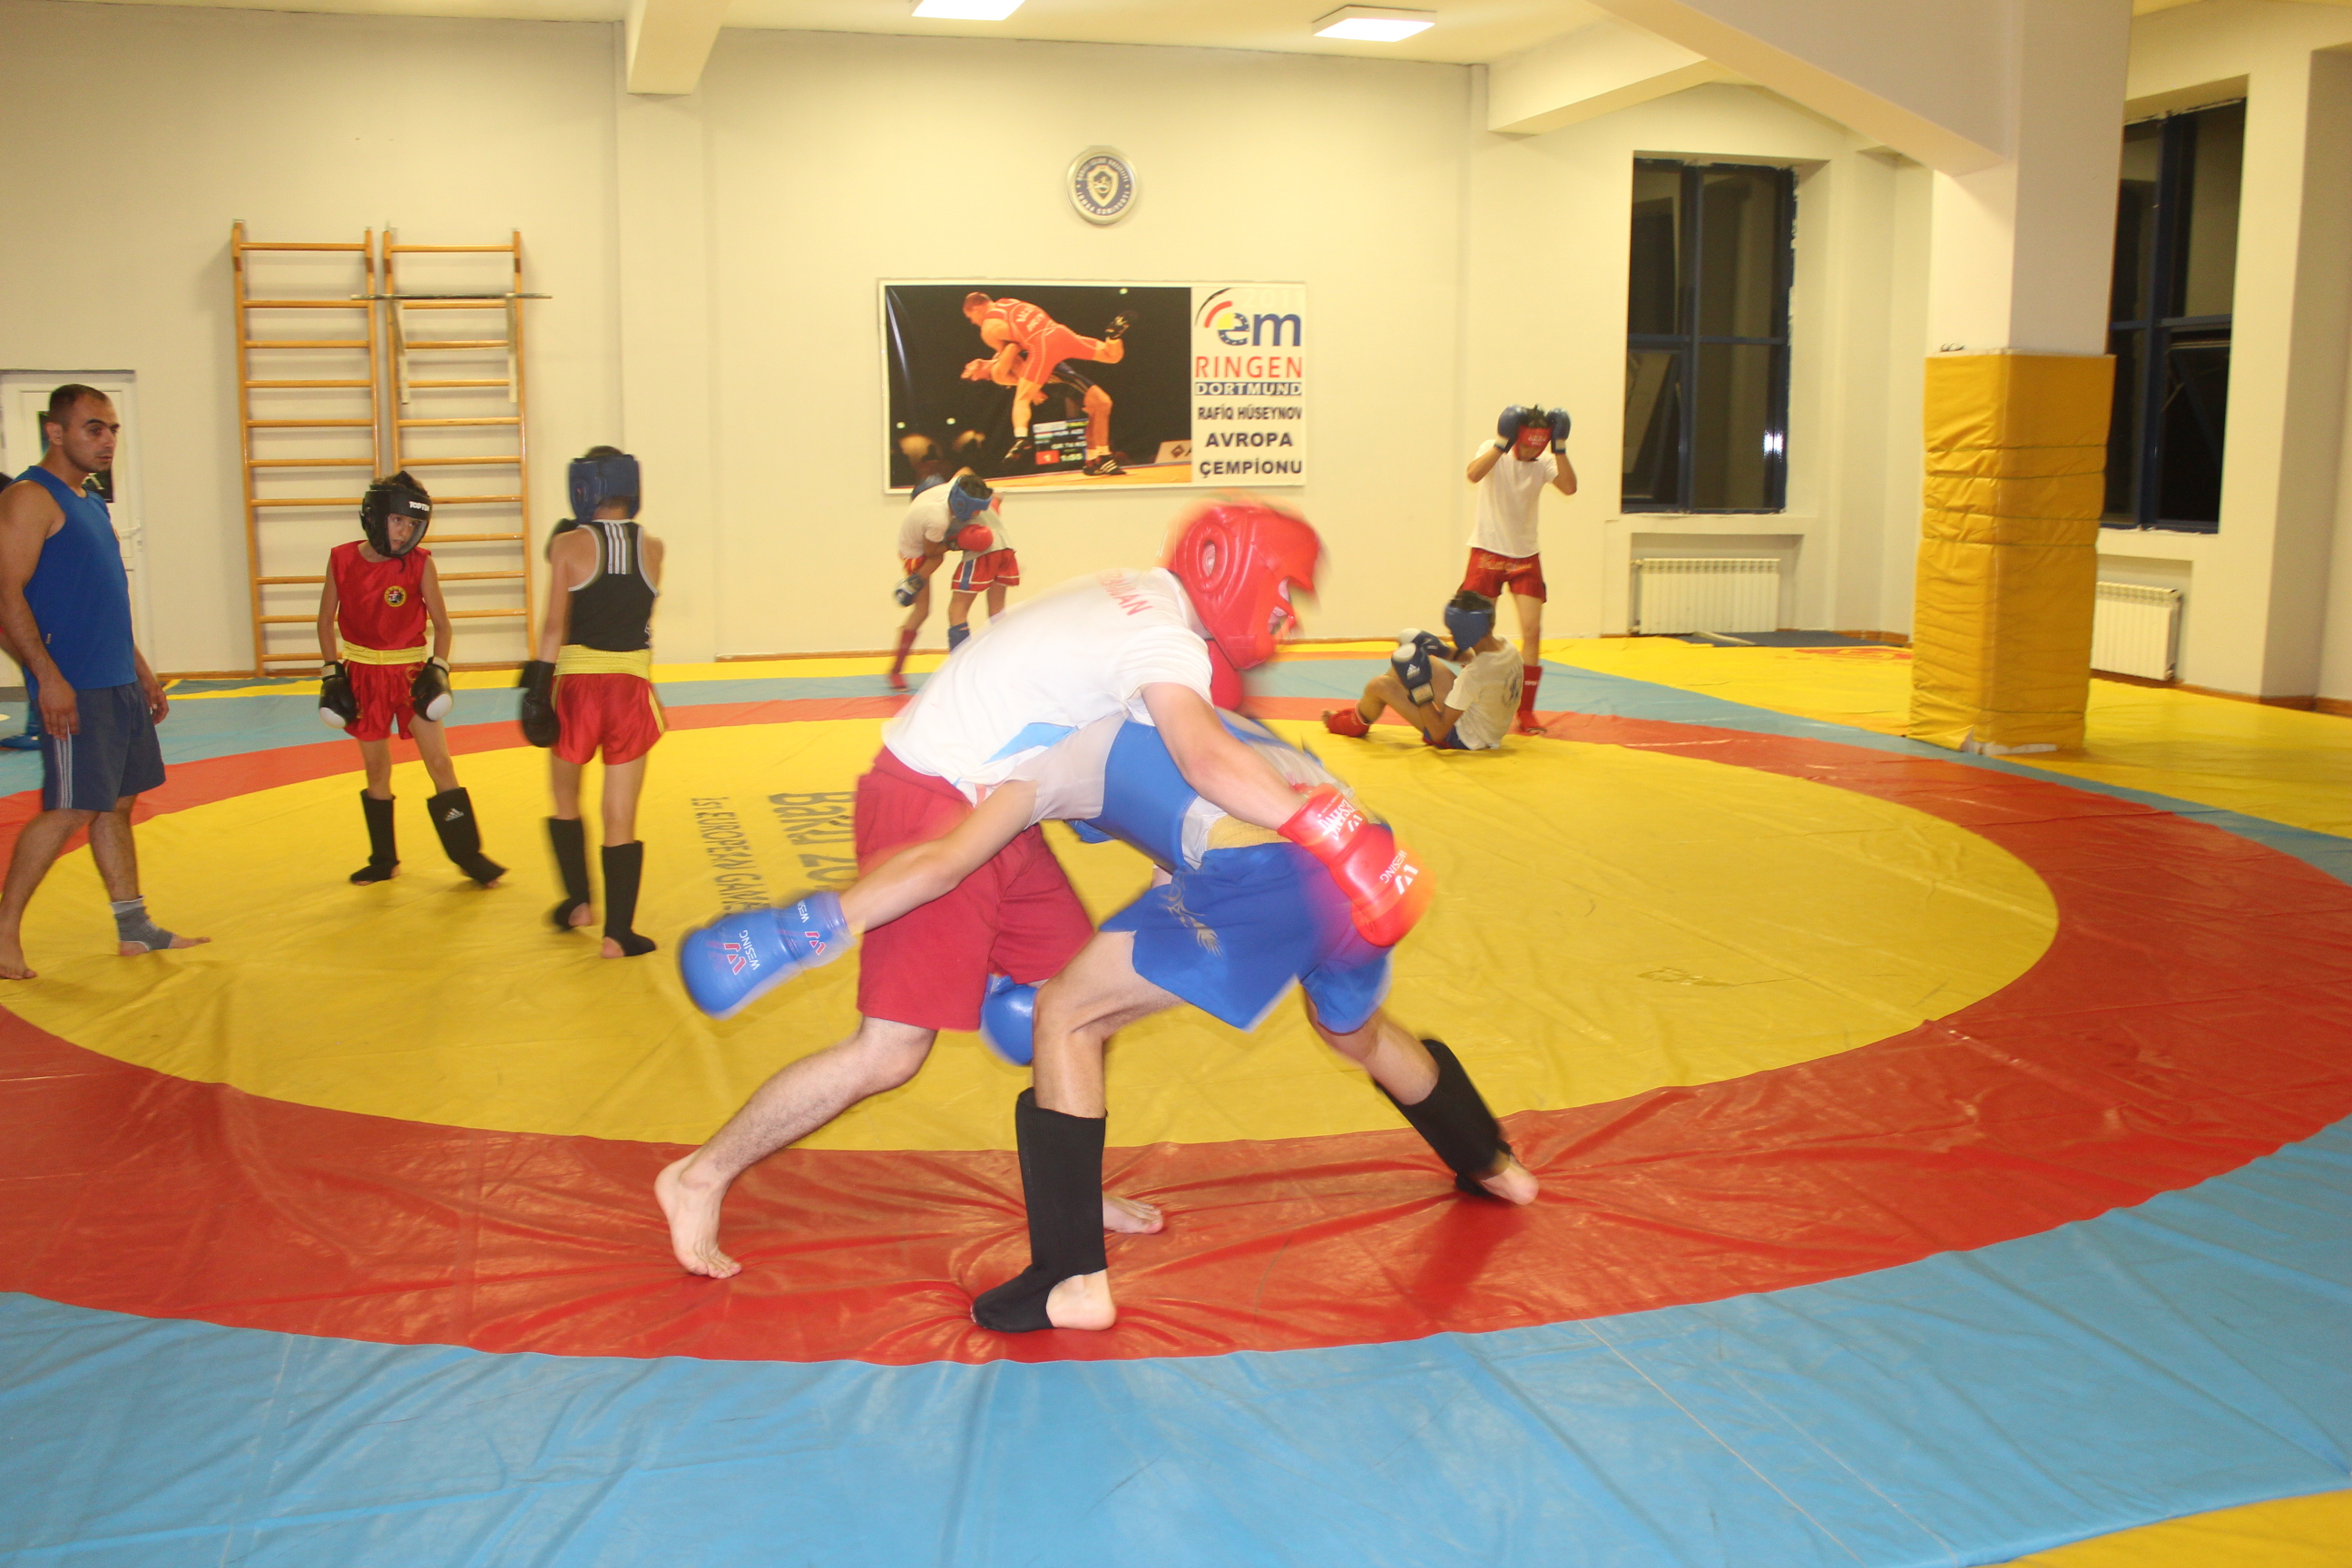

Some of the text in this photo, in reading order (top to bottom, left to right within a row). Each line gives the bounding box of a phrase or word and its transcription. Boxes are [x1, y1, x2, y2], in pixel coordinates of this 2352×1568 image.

[1217, 312, 1301, 347] em
[1195, 356, 1302, 378] RINGEN
[1195, 382, 1302, 396] DORTMUND
[1237, 405, 1302, 420] HÜSEYNOV
[1205, 432, 1293, 447] AVROPA
[1200, 458, 1302, 478] ÇEMPİONU
[695, 811, 757, 869] EUROPEAN
[1379, 849, 1408, 884] WESING
[713, 873, 771, 912] GAME
[740, 929, 760, 971] WESING
